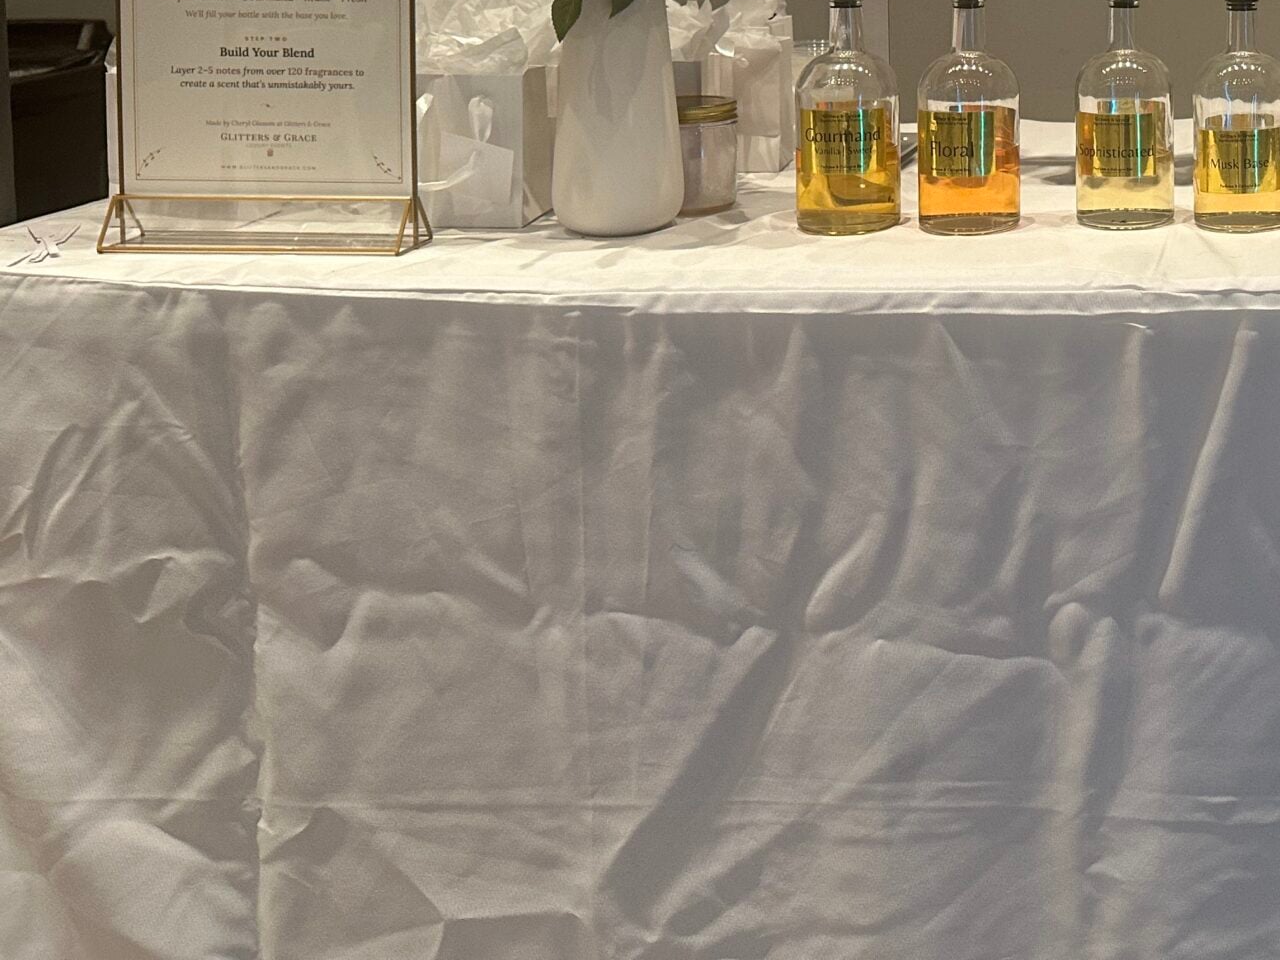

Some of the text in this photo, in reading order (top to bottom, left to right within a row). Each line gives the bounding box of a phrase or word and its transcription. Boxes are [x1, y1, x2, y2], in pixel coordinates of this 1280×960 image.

[219, 46, 315, 58] Build Your Blend
[170, 65, 195, 76] Layer
[216, 66, 240, 75] notes
[242, 66, 264, 77] from
[288, 67, 303, 76] 120
[304, 67, 353, 78] fragrances
[217, 80, 240, 88] scent
[242, 80, 266, 88] that's
[268, 81, 327, 91] unmistakably
[220, 132, 269, 141] GLITTERS
[284, 133, 318, 142] GRACE
[805, 127, 880, 143] Gourmand
[930, 141, 974, 158] Floral
[1079, 144, 1155, 160] Sophisticated
[1211, 158, 1270, 170] Musk Base
